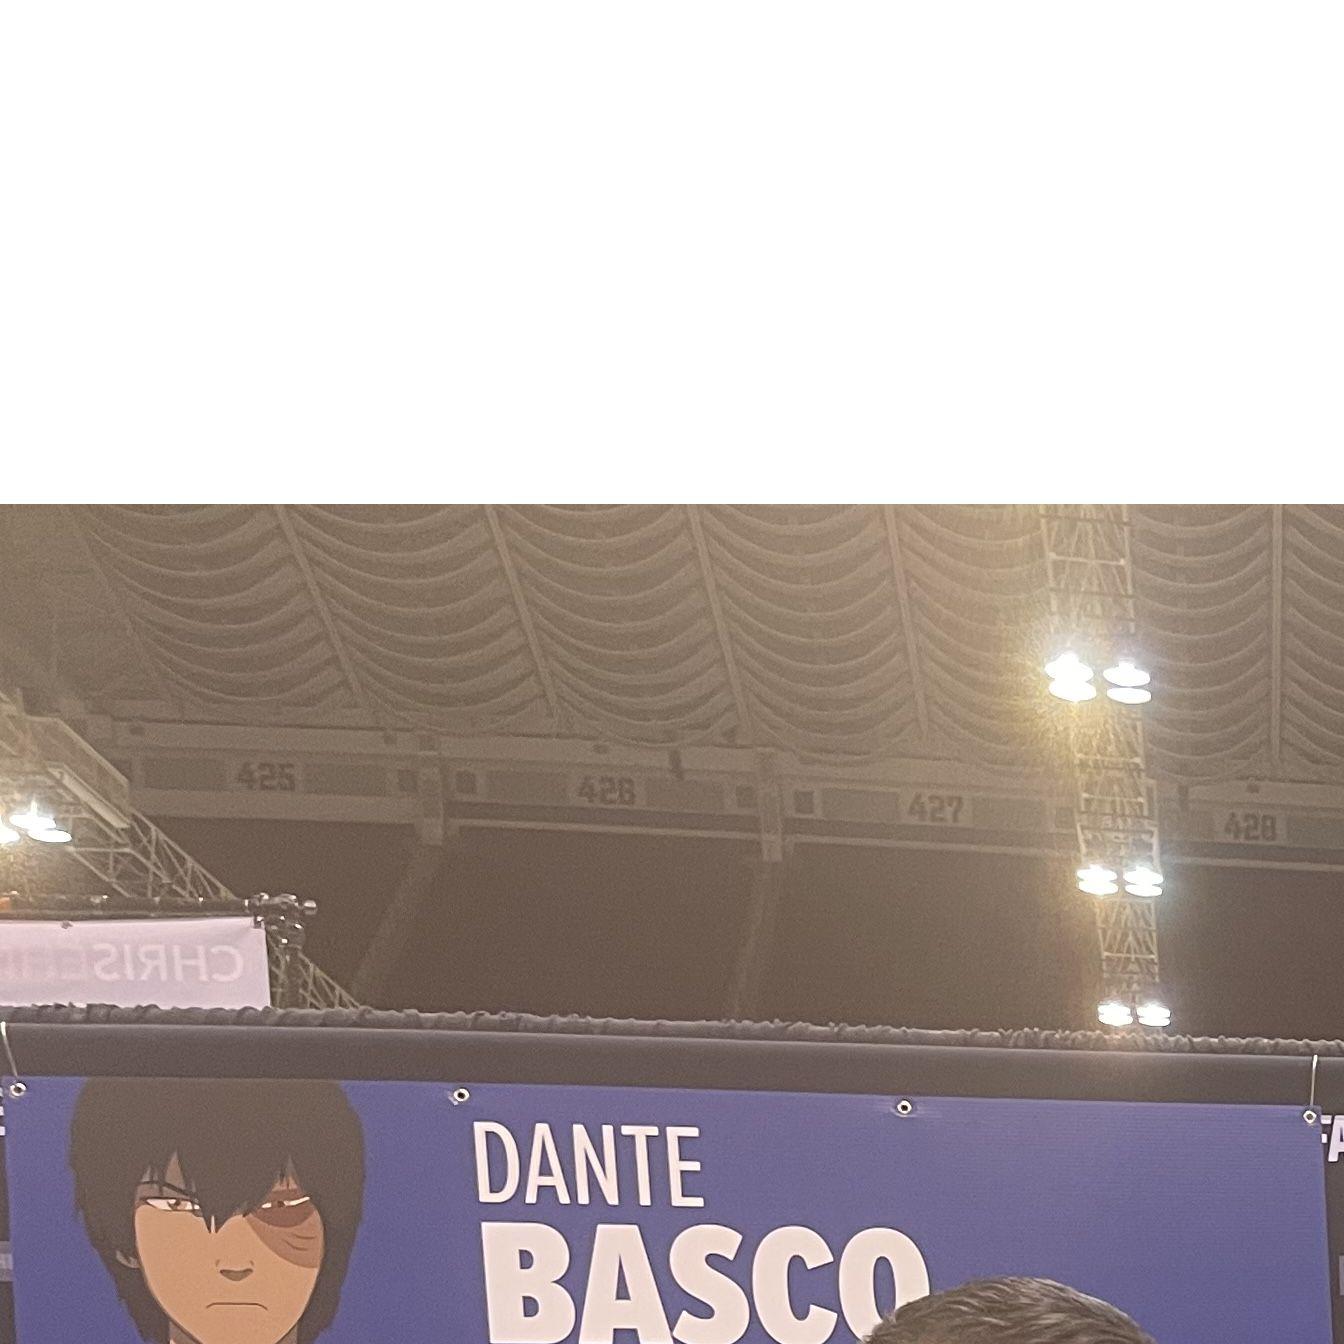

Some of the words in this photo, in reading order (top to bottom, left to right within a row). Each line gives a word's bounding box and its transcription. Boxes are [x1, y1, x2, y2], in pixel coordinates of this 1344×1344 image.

[236, 762, 295, 791] 425
[908, 795, 963, 823] 427
[1223, 813, 1277, 842] 428
[473, 1121, 704, 1207] DANTE
